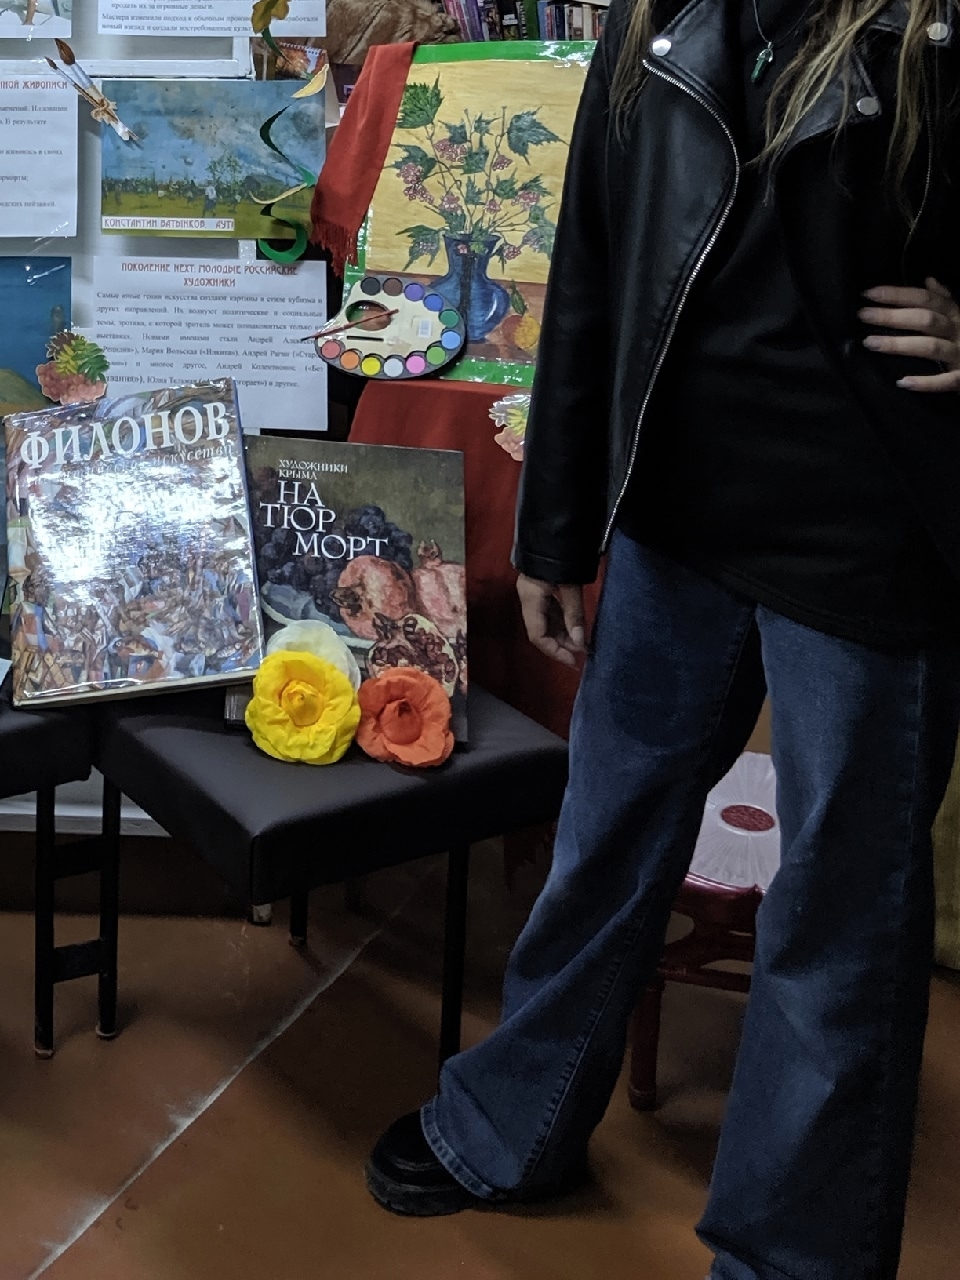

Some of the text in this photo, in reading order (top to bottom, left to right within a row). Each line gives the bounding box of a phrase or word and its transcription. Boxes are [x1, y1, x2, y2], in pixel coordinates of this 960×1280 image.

[22, 81, 68, 89] ЖИВОПИСИ
[104, 219, 157, 227] КОНСТАНТИН
[161, 220, 207, 228] БАТЫНКОВ.
[121, 262, 298, 276] ПОКОЛЕНИЕ NEXT. МОЛОДЫЕ РОССИЙСКИЕ
[184, 277, 236, 287] ХУДОЖНИКИ
[20, 401, 230, 469] ФИЛОНОВ
[278, 459, 348, 473] ХУДОЖНИКИ
[278, 469, 318, 479] КРЫМА
[278, 480, 325, 508] НА
[260, 501, 336, 532] ТЮР
[292, 532, 388, 560] МОРТ
